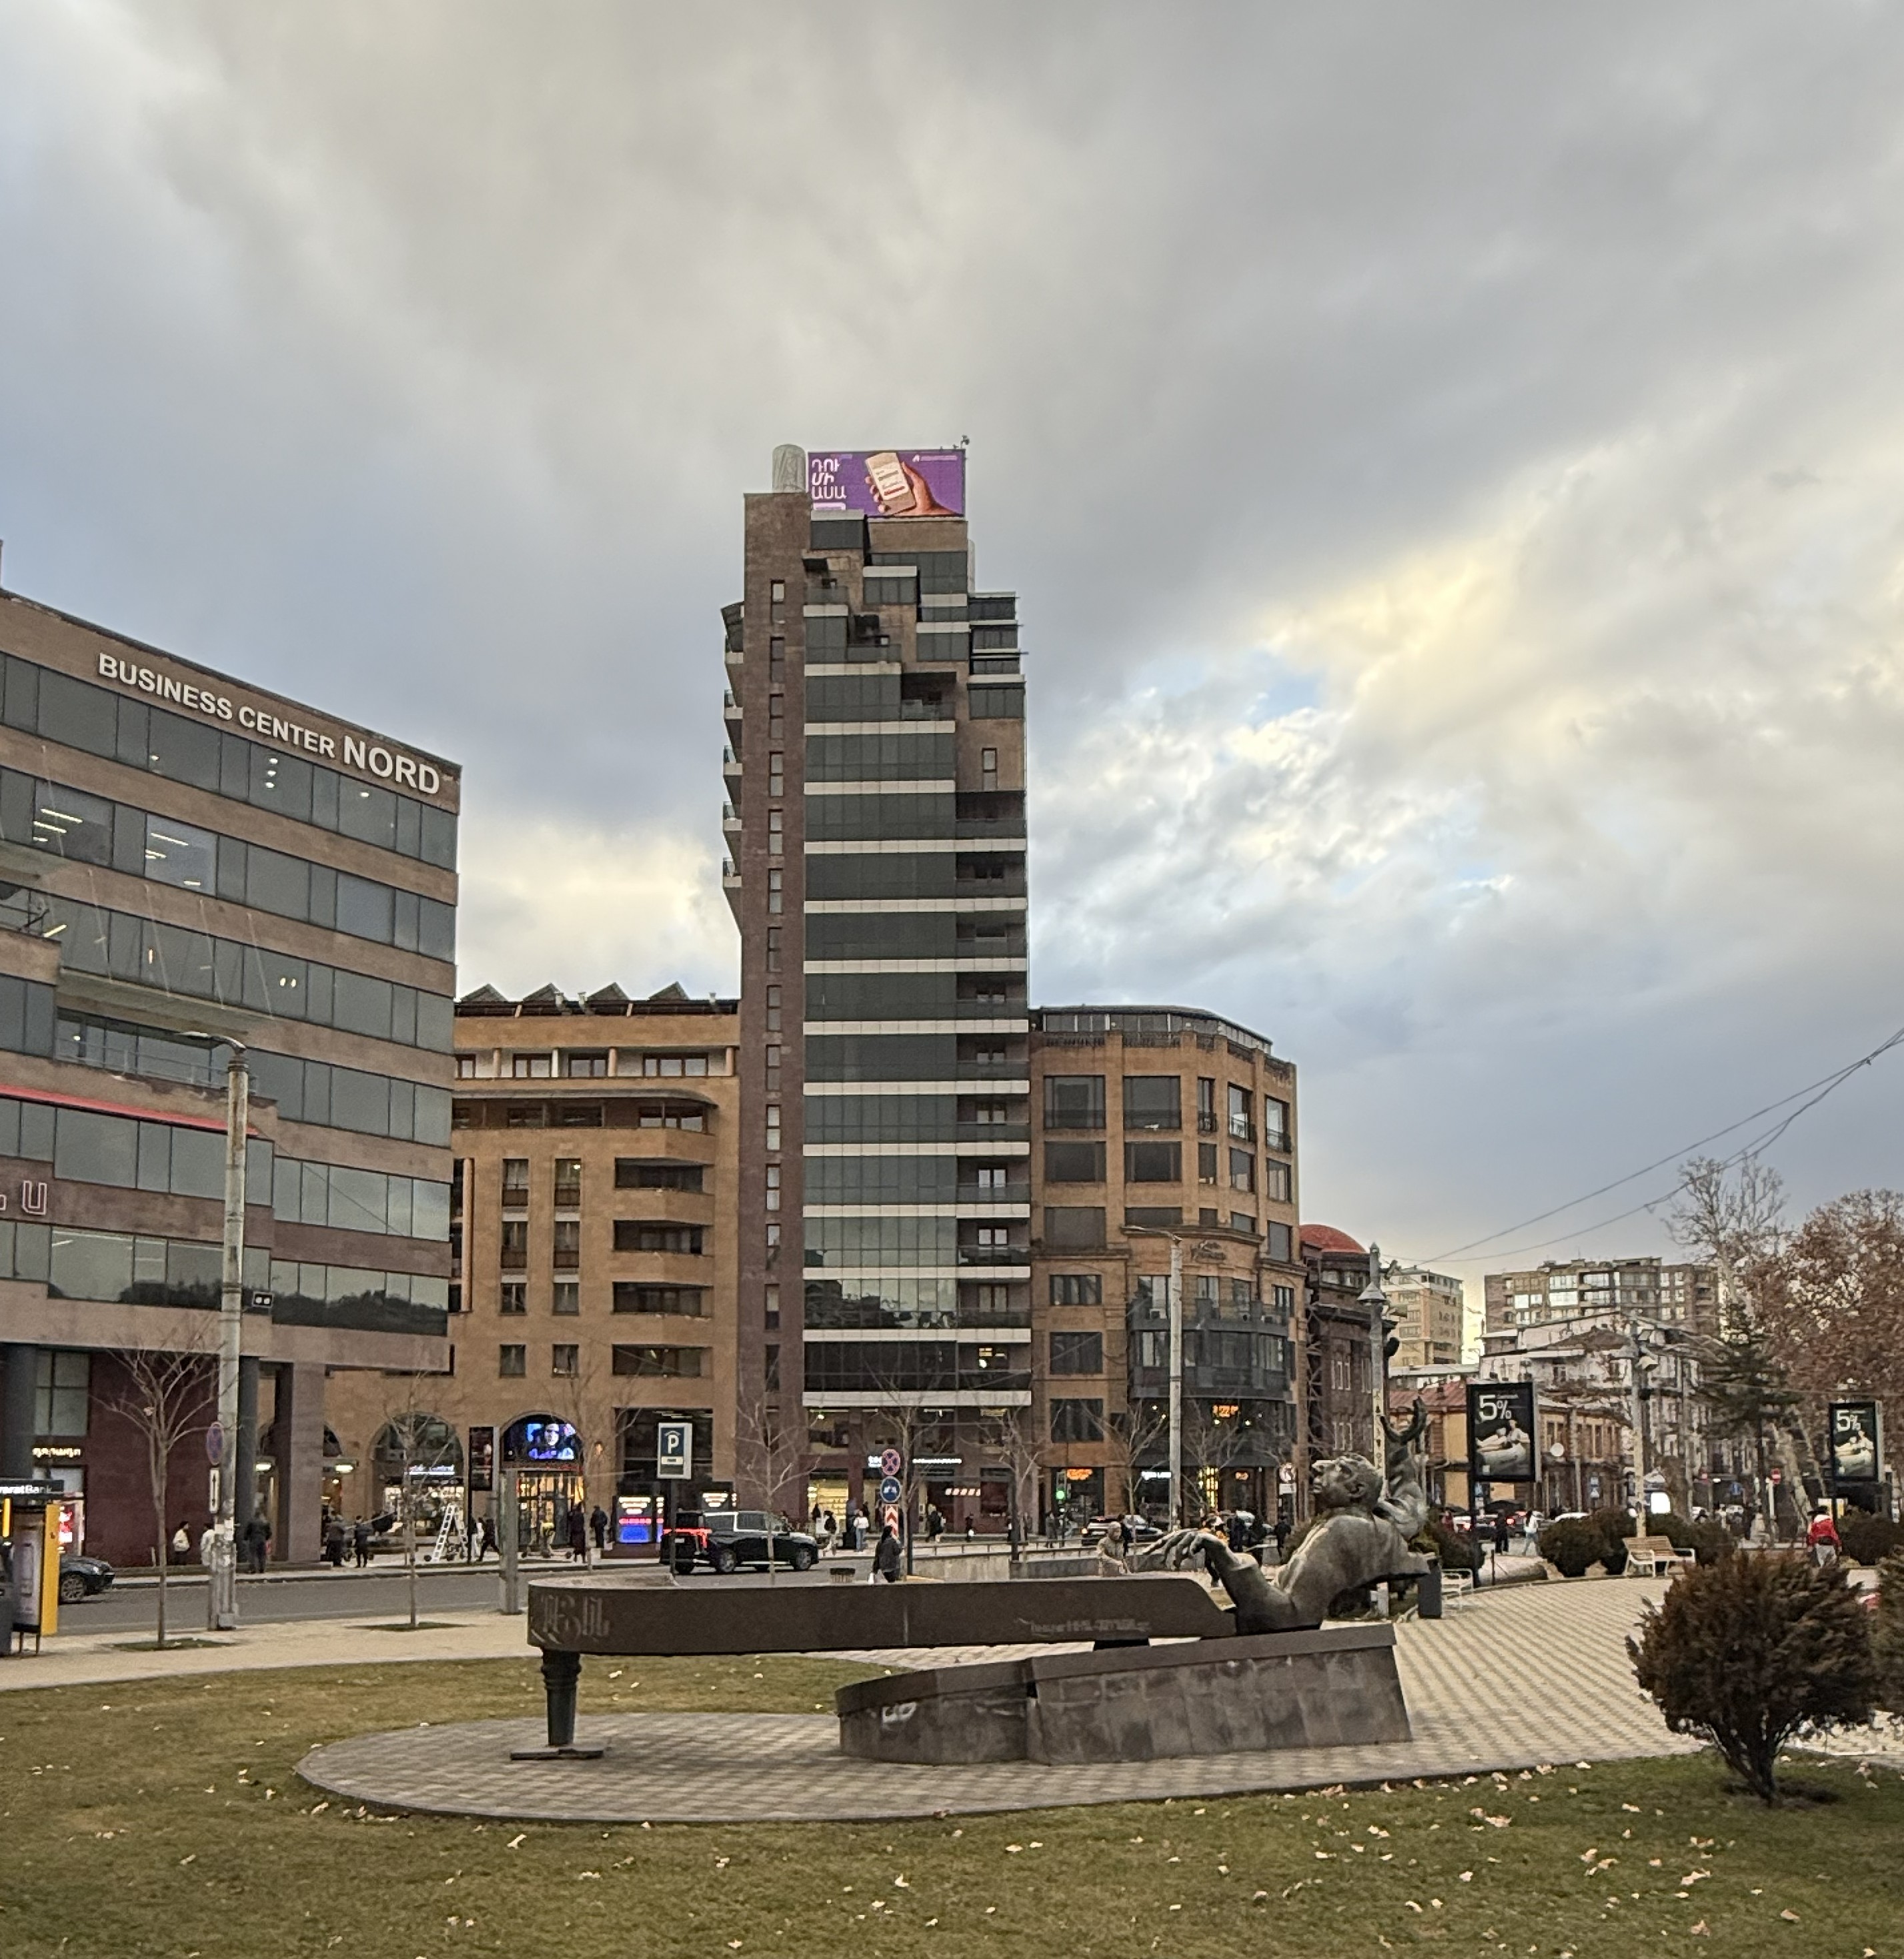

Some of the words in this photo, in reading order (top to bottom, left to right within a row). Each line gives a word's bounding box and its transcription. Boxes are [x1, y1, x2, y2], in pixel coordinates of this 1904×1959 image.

[99, 652, 233, 721] BUSINESS
[239, 706, 335, 758] CENTER
[343, 735, 439, 795] NORD
[1479, 1394, 1512, 1421] 5%
[1836, 1409, 1861, 1432] 5%
[668, 1433, 680, 1454] P
